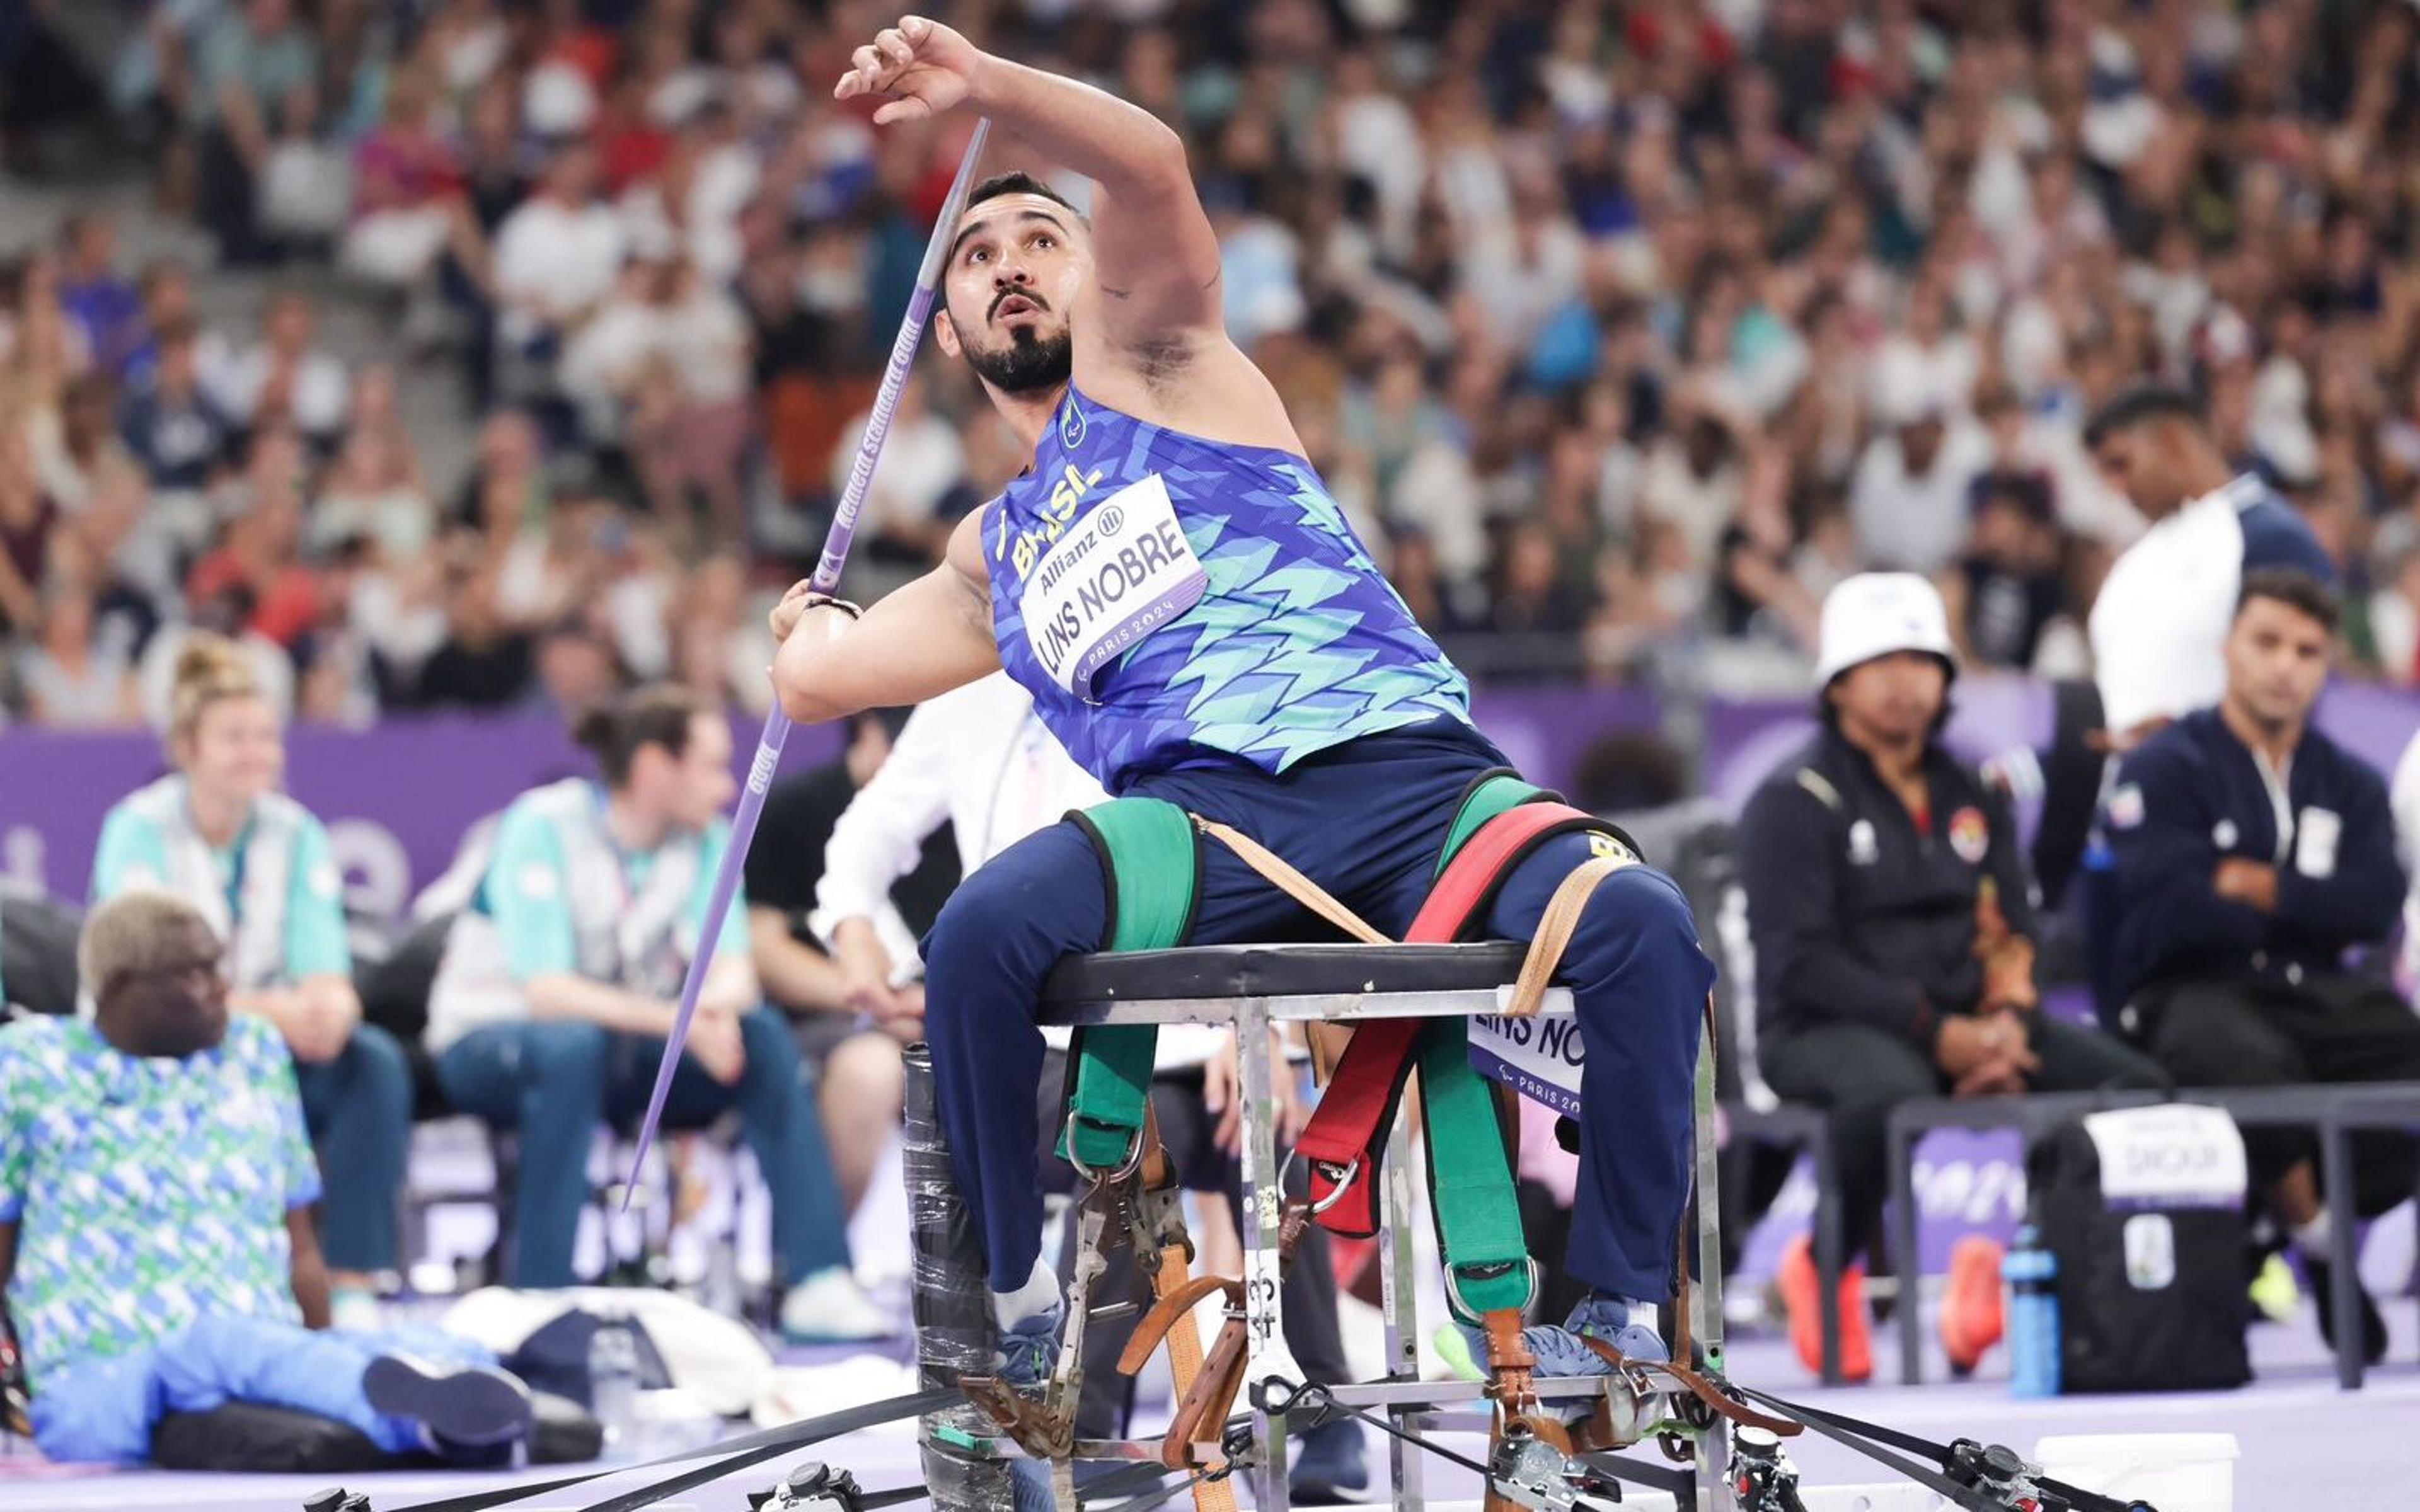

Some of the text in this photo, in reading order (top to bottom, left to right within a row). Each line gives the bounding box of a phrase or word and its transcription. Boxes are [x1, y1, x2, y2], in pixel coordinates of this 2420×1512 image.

[1040, 530, 1098, 597] Allianz
[1038, 519, 1185, 675] LINS NOBRE
[1088, 601, 1174, 665] PARIS 2024
[1475, 1014, 1531, 1046] NS
[1519, 1076, 1557, 1104] PARIS
